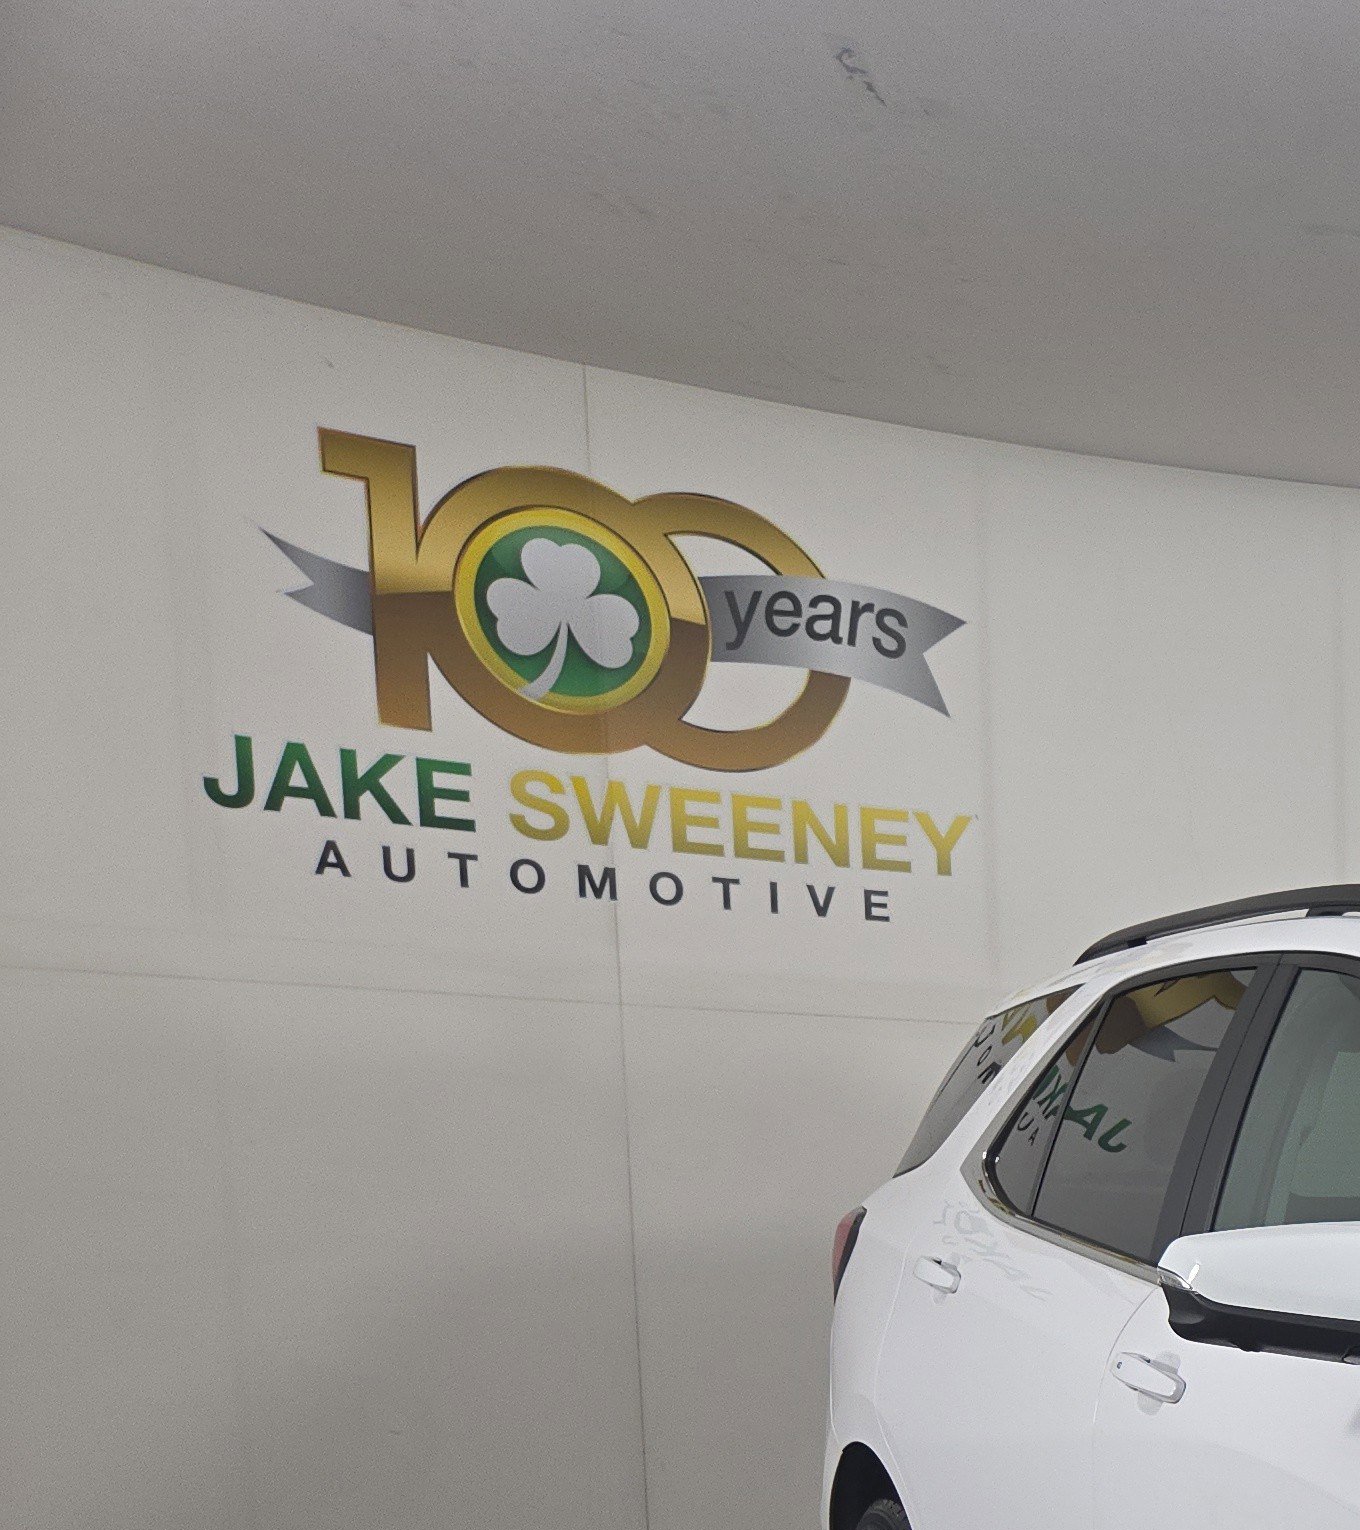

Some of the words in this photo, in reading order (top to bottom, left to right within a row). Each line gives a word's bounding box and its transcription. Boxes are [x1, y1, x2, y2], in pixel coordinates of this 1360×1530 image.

[723, 584, 909, 660] years
[203, 734, 477, 832] JAKE
[509, 769, 973, 876] SWEENEY
[315, 838, 892, 922] AUTOMOTIVE
